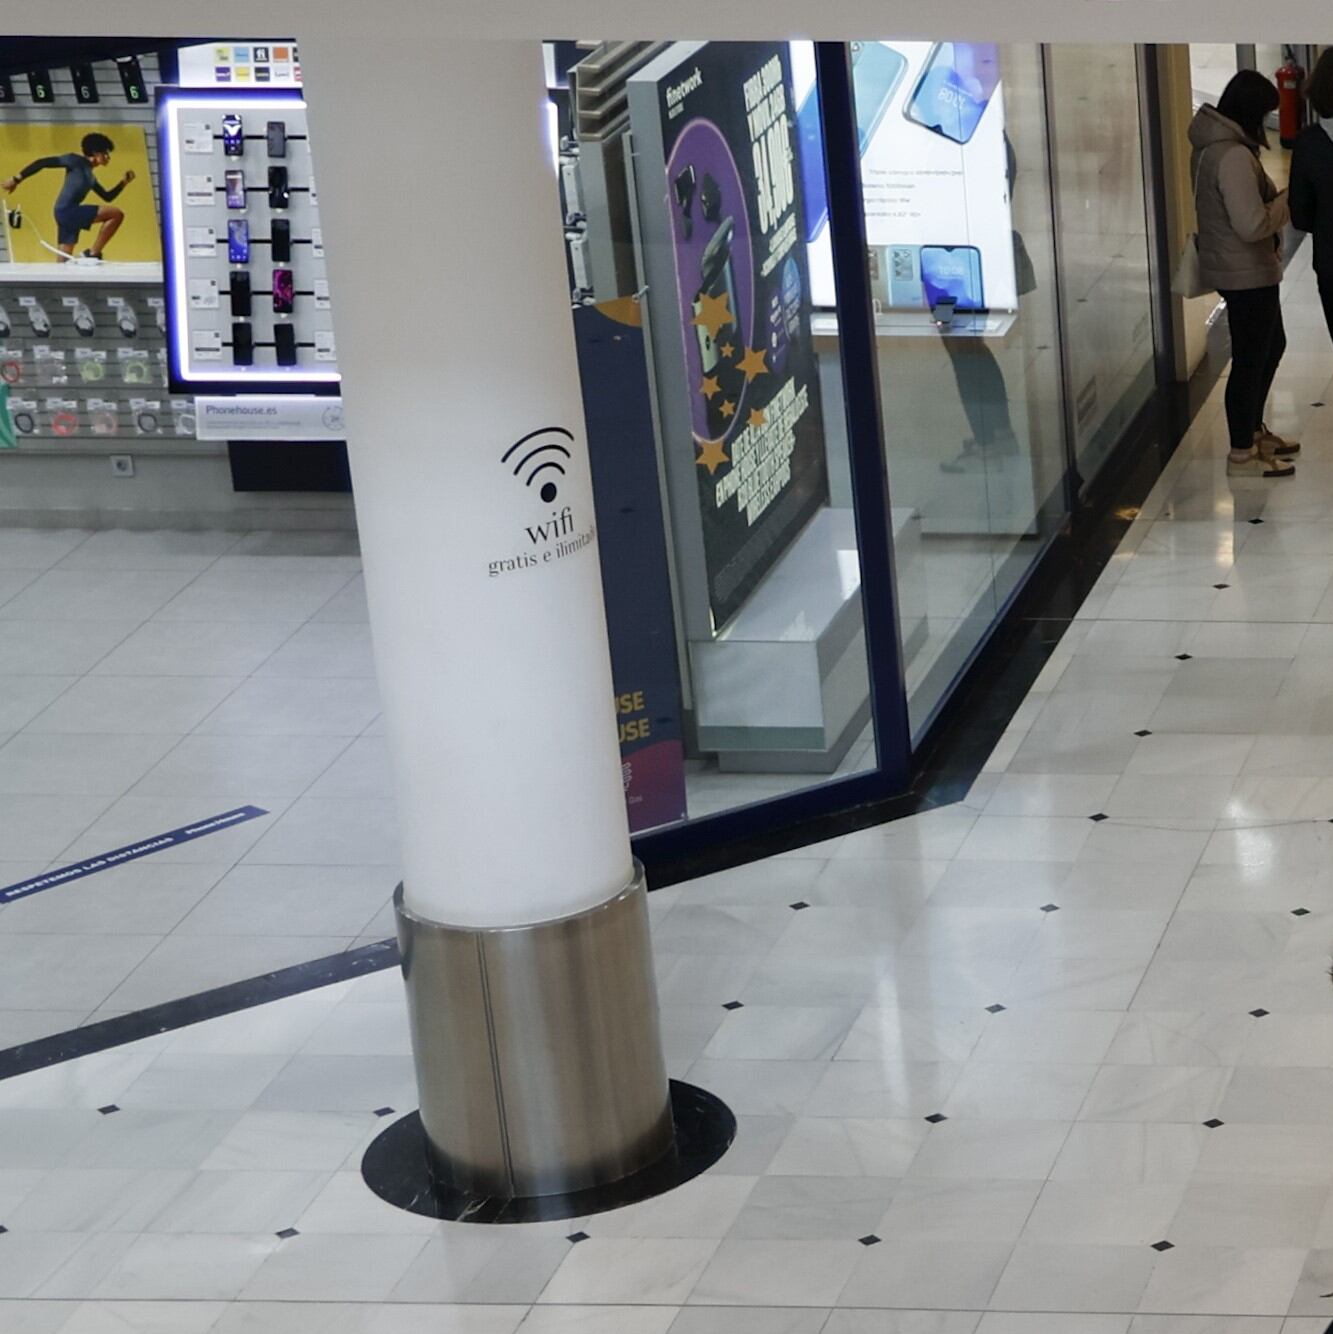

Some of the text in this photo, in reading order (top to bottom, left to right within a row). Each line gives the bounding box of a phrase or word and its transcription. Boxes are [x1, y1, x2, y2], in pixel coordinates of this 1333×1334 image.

[525, 506, 574, 545] wifi
[488, 552, 538, 577] gratis
[543, 551, 552, 563] e
